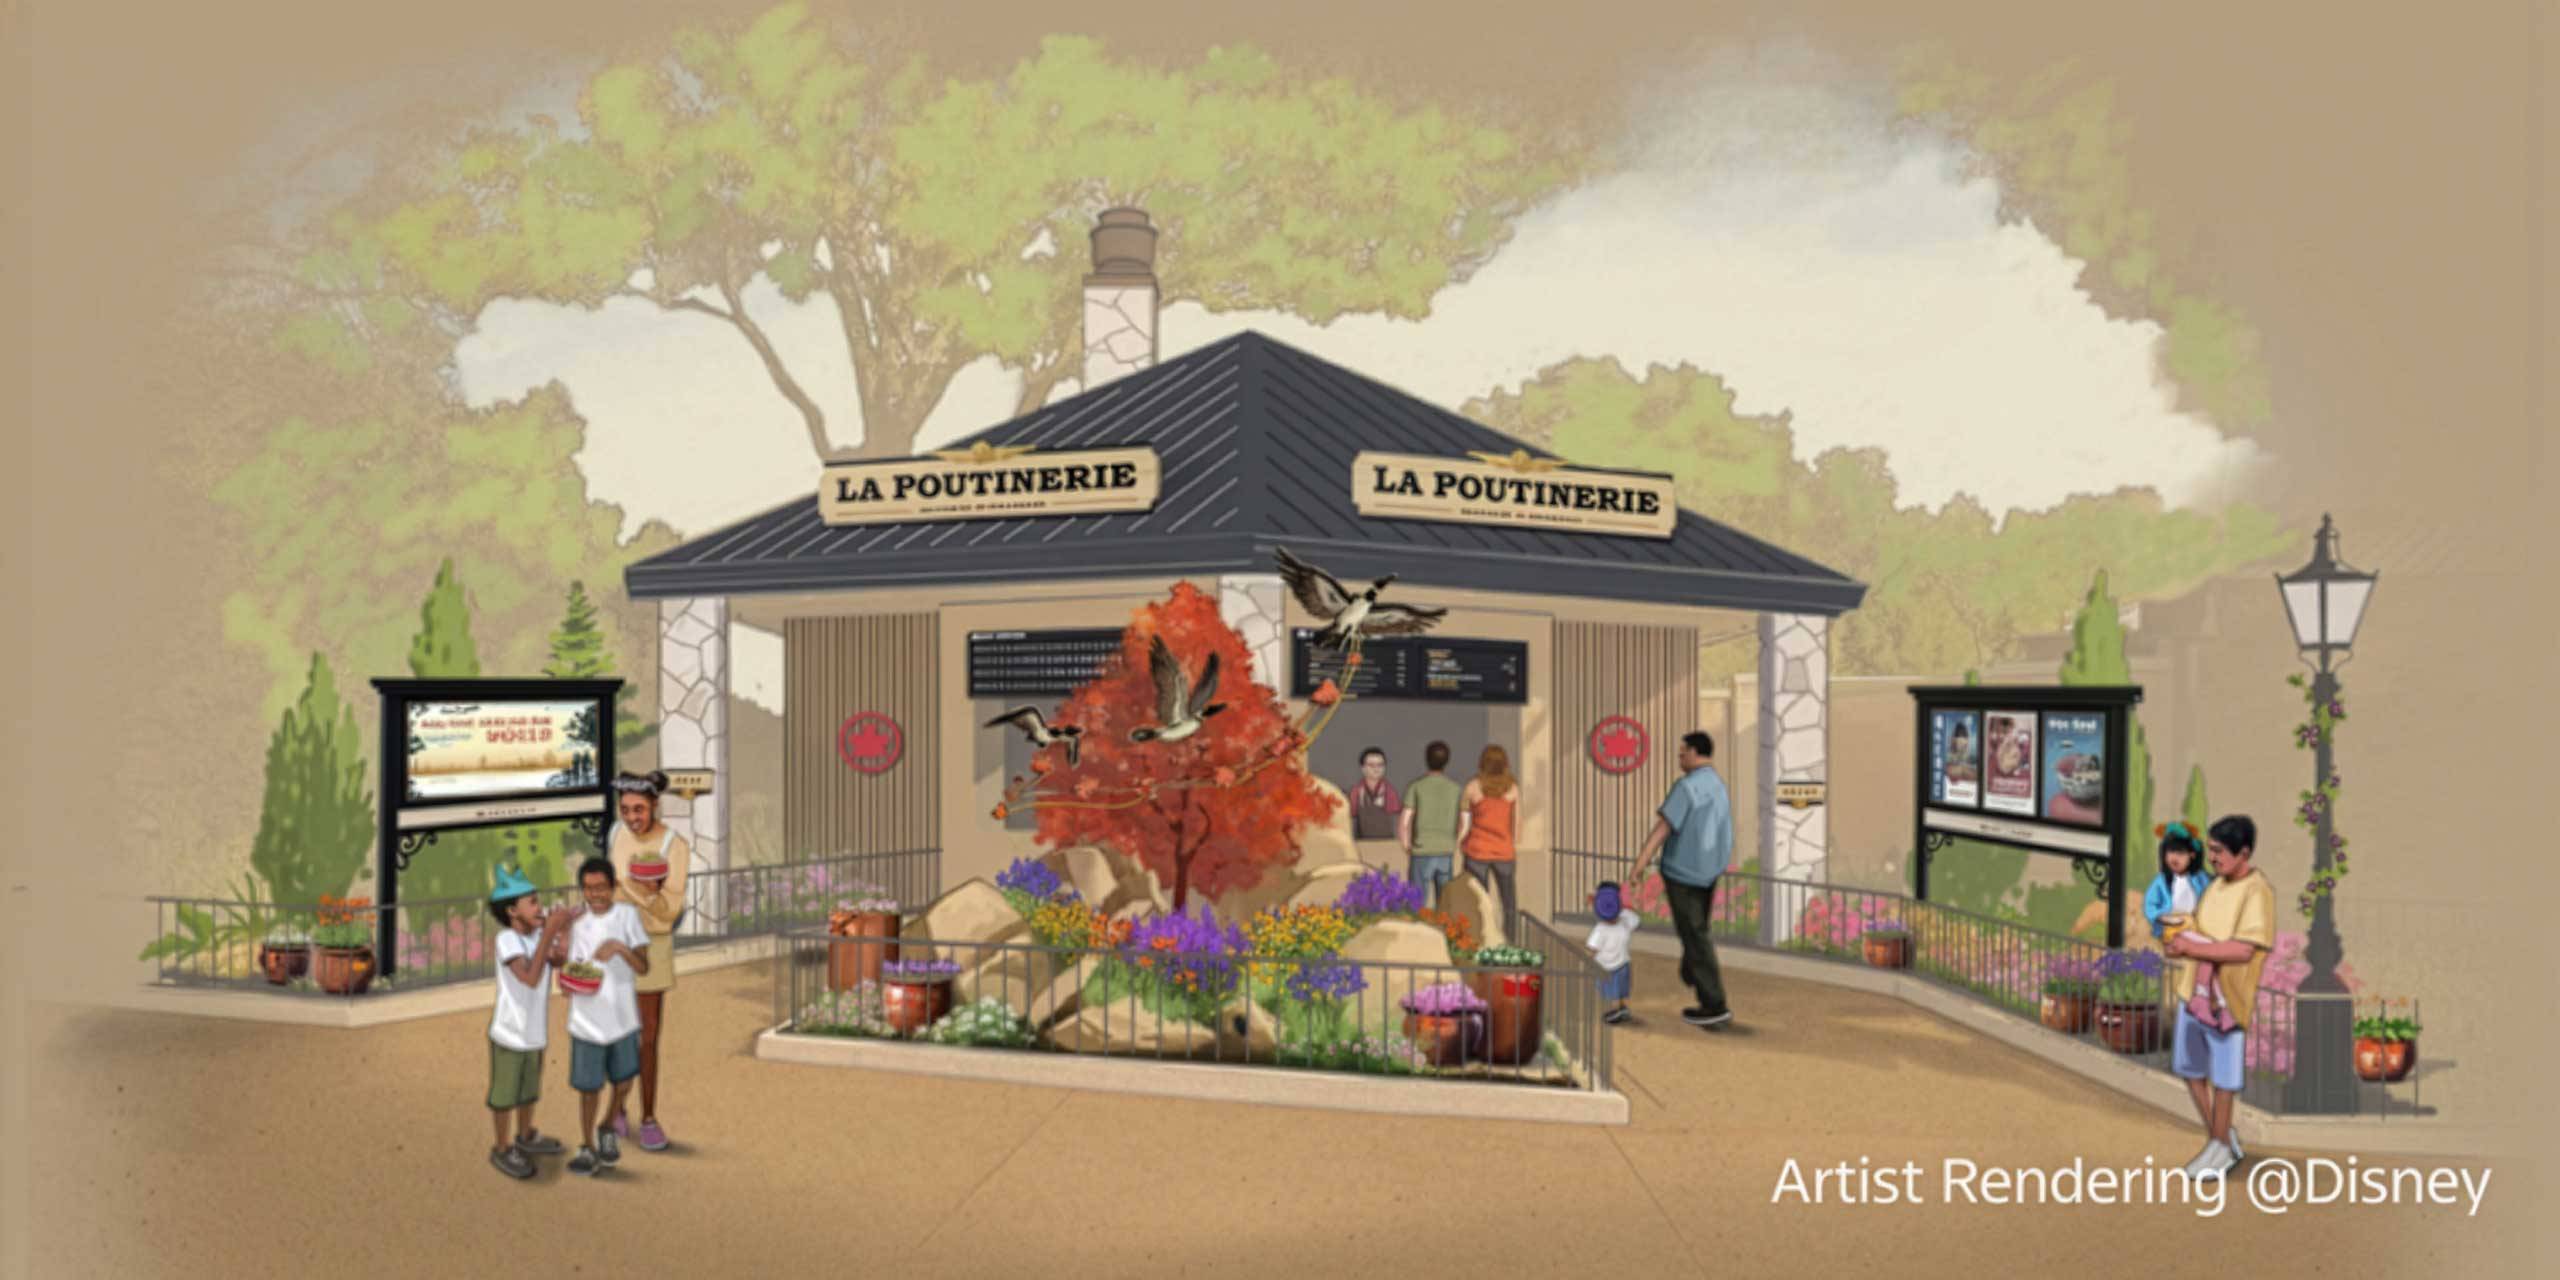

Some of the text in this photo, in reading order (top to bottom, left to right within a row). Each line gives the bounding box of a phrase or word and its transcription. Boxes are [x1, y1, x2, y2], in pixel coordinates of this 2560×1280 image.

[837, 463, 1137, 502] LA POUTINERIE
[1373, 466, 1661, 516] LA POUTINERIE
